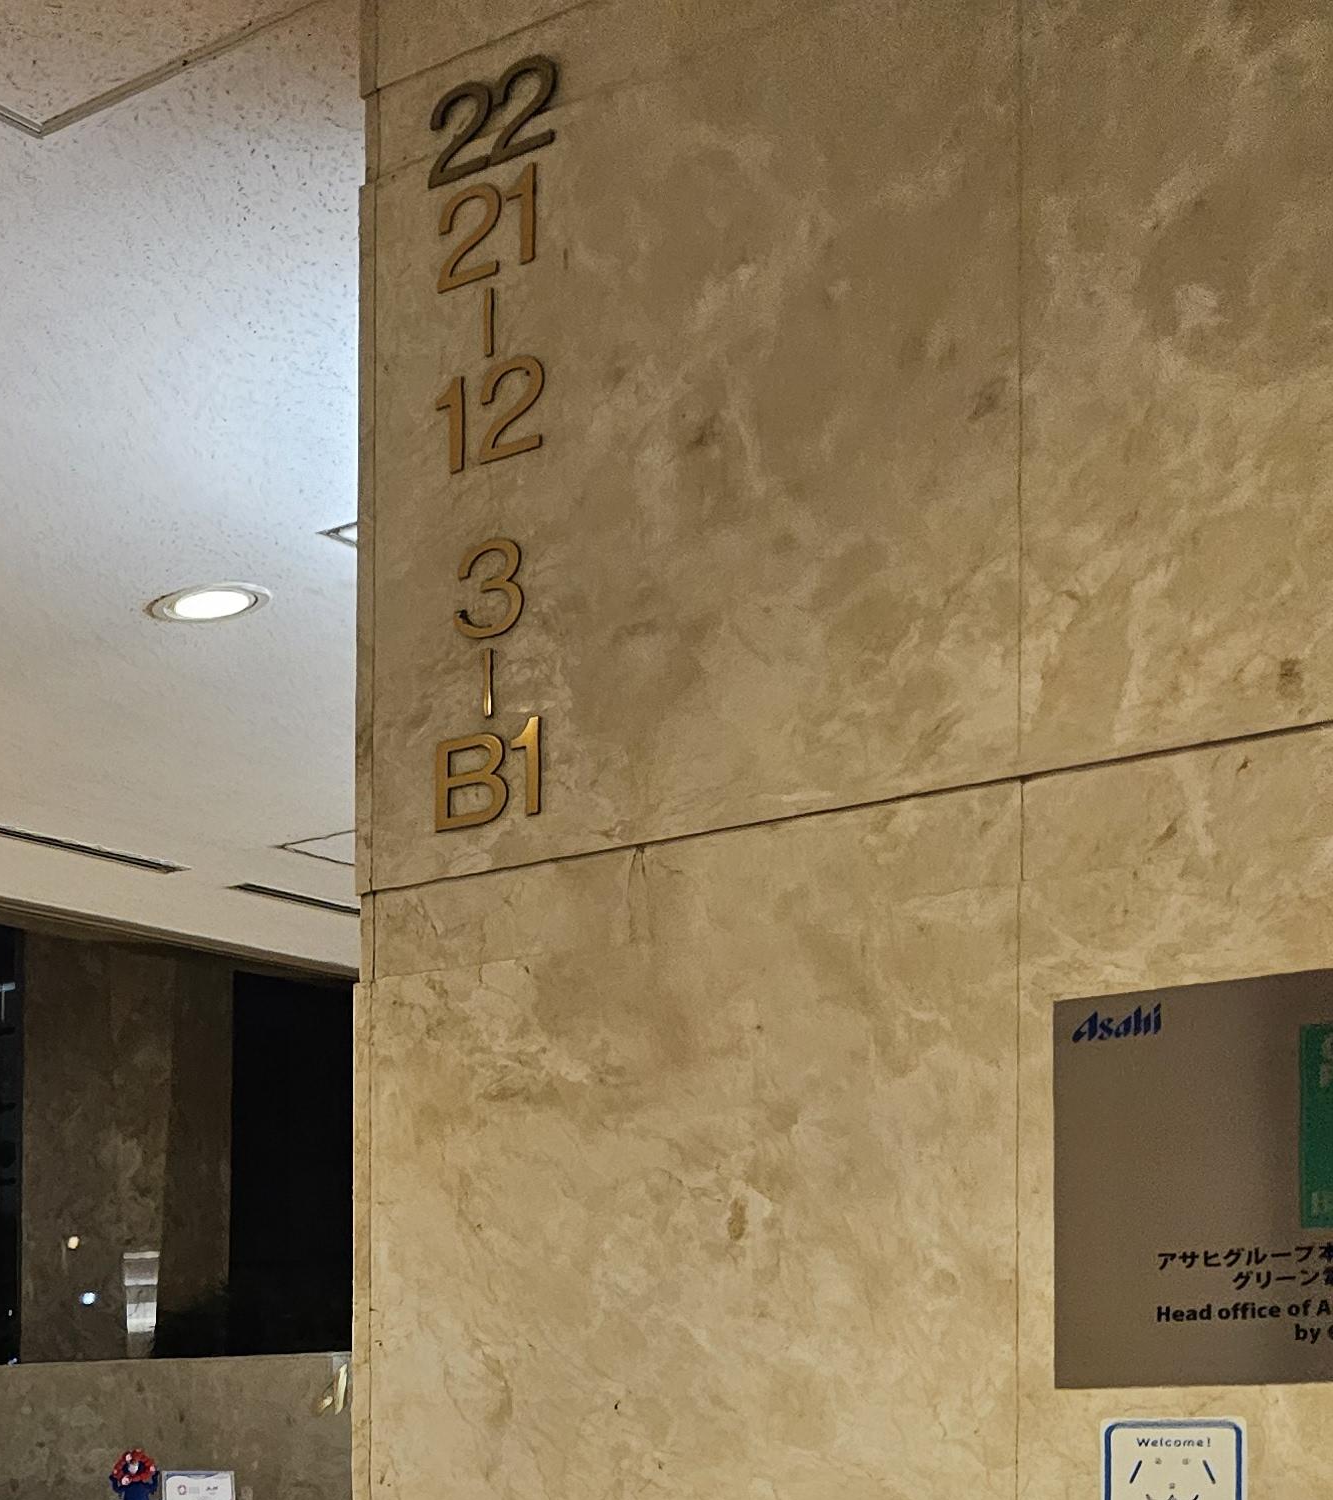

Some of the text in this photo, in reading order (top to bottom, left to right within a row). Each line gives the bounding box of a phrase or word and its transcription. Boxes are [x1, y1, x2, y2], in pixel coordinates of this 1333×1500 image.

[428, 54, 559, 188] 22
[437, 162, 539, 294] 21
[435, 355, 545, 475] 12
[454, 538, 525, 640] 3
[435, 716, 543, 834] B1
[1072, 1003, 1162, 1043] Asahi
[1157, 1304, 1212, 1322] Head
[1218, 1302, 1281, 1321] office
[1288, 1300, 1312, 1316] of
[1294, 1323, 1321, 1344] by
[1136, 1437, 1211, 1448] Welcome!
